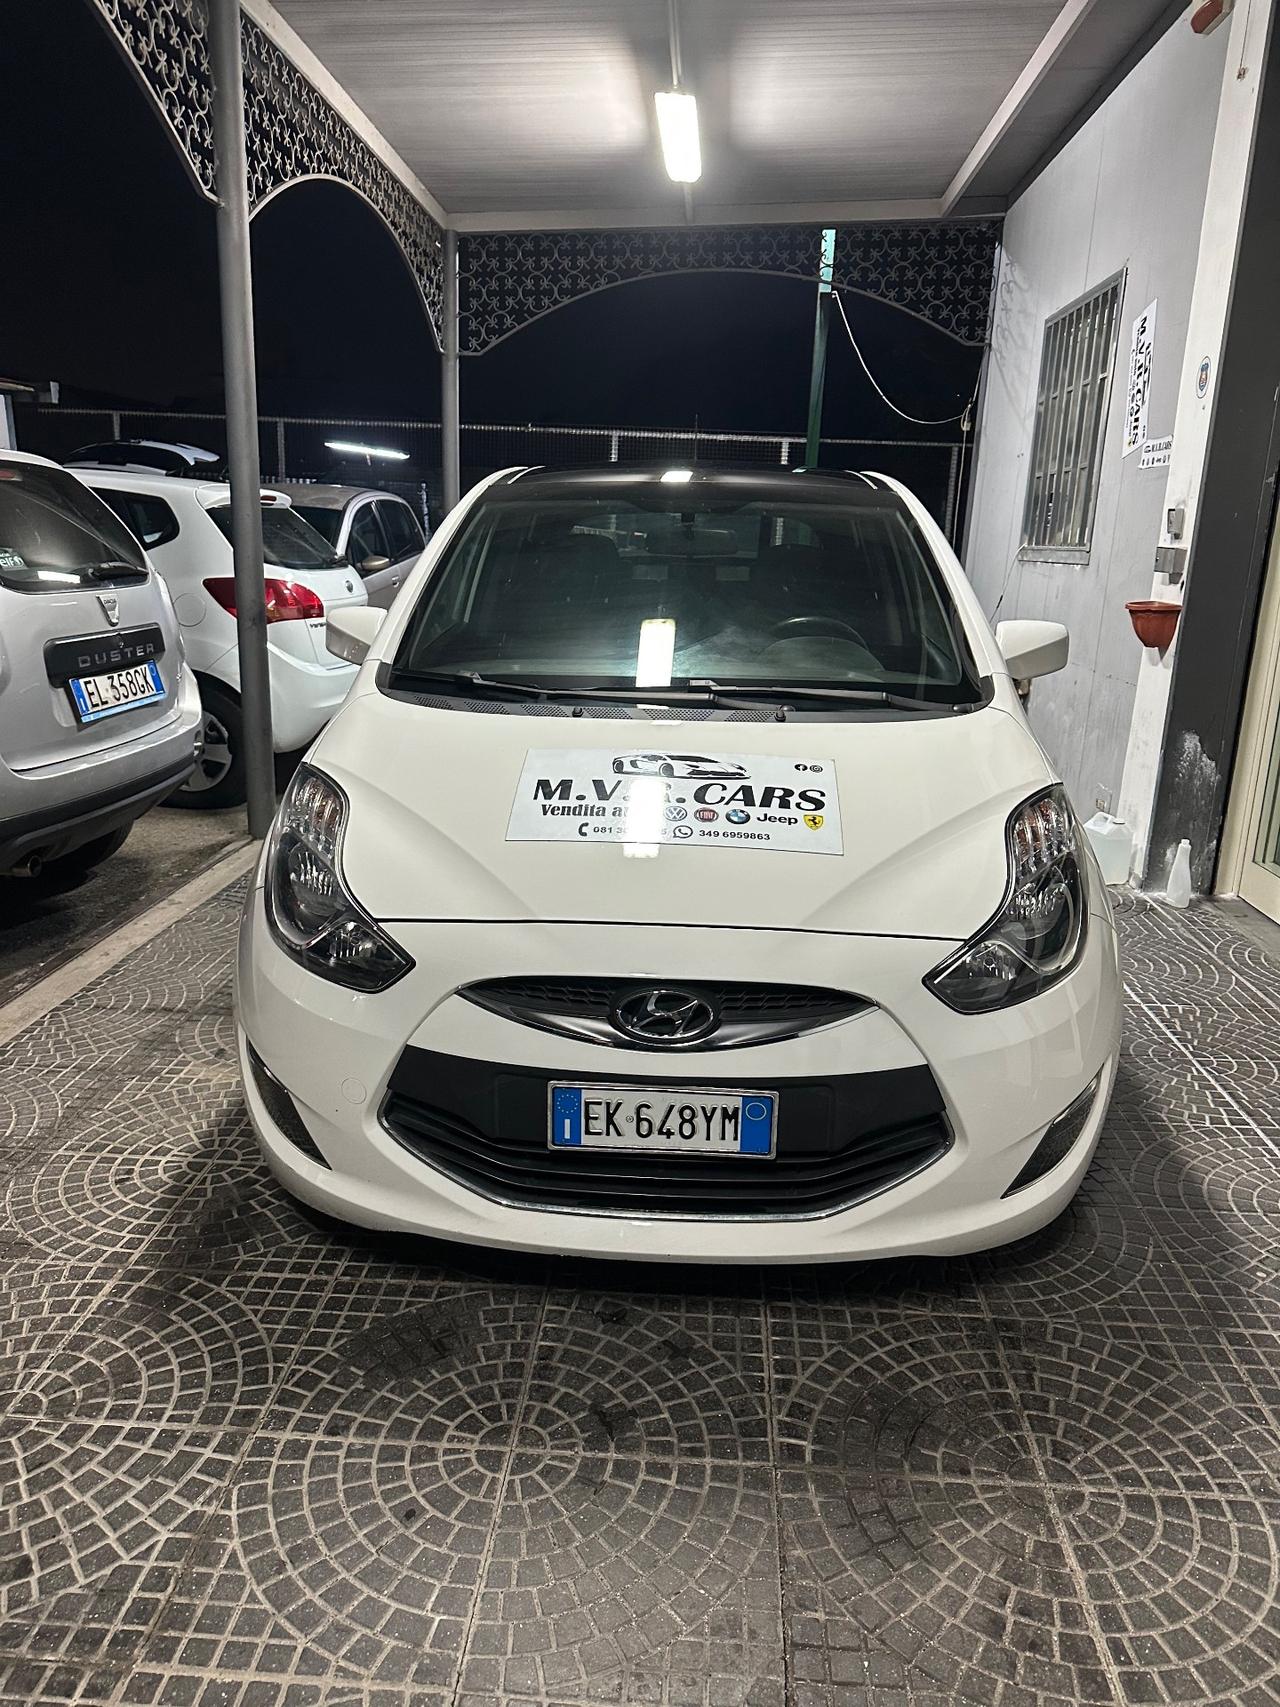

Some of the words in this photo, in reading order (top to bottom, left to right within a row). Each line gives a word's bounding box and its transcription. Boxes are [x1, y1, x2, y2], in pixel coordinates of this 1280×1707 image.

[78, 643, 154, 667] DUSTER
[83, 678, 109, 708] EL
[106, 666, 155, 701] 358GK
[541, 803, 606, 817] Vendita
[757, 813, 798, 826] Jeep
[593, 826, 613, 834] 081
[699, 829, 720, 838] 349
[722, 831, 771, 841] 6959863
[583, 1098, 625, 1137] EK
[634, 1101, 740, 1142] 648YM
